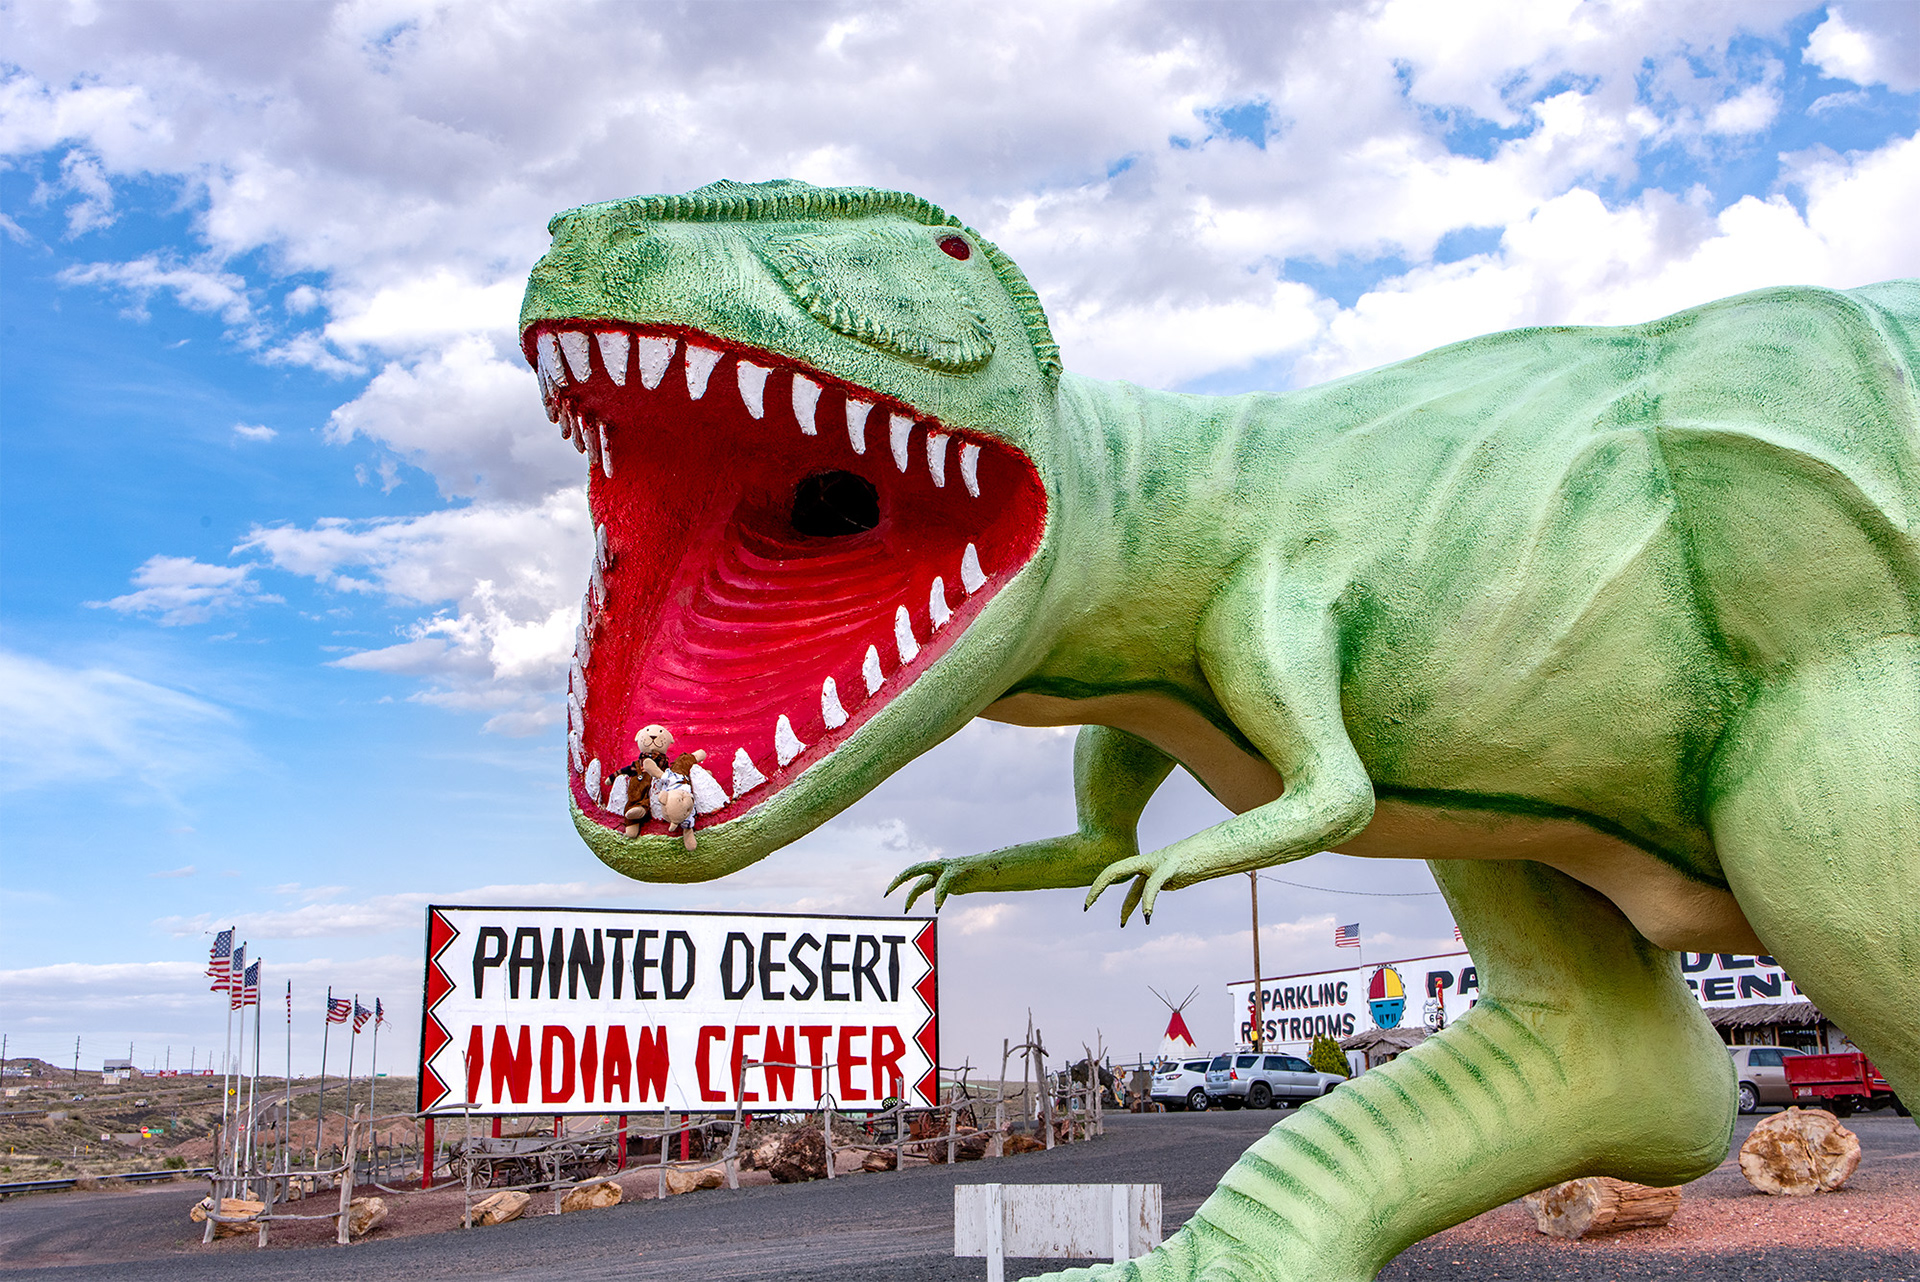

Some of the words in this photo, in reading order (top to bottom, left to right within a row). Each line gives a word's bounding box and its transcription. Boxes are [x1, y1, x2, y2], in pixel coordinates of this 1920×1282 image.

[472, 926, 696, 1000] PAINTED
[720, 932, 906, 1002] DESERT
[465, 1024, 670, 1104] INDIAN
[695, 1025, 905, 1103] CENTER
